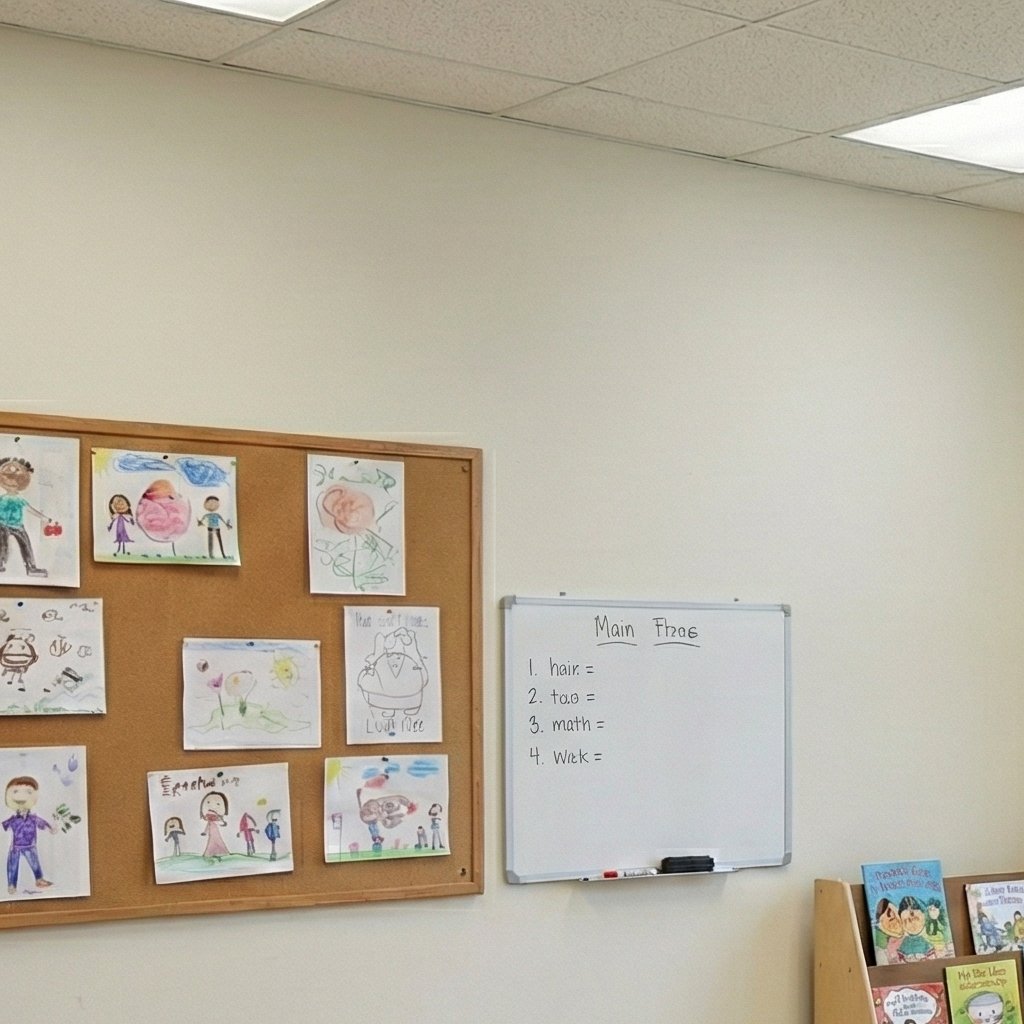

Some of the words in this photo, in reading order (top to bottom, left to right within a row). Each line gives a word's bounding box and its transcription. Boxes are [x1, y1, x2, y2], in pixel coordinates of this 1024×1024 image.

[594, 615, 635, 638] Main
[529, 658, 537, 676] 1.
[528, 687, 542, 704] 2.
[529, 715, 544, 734] 3.
[552, 716, 591, 731] math
[530, 747, 544, 765] 4.
